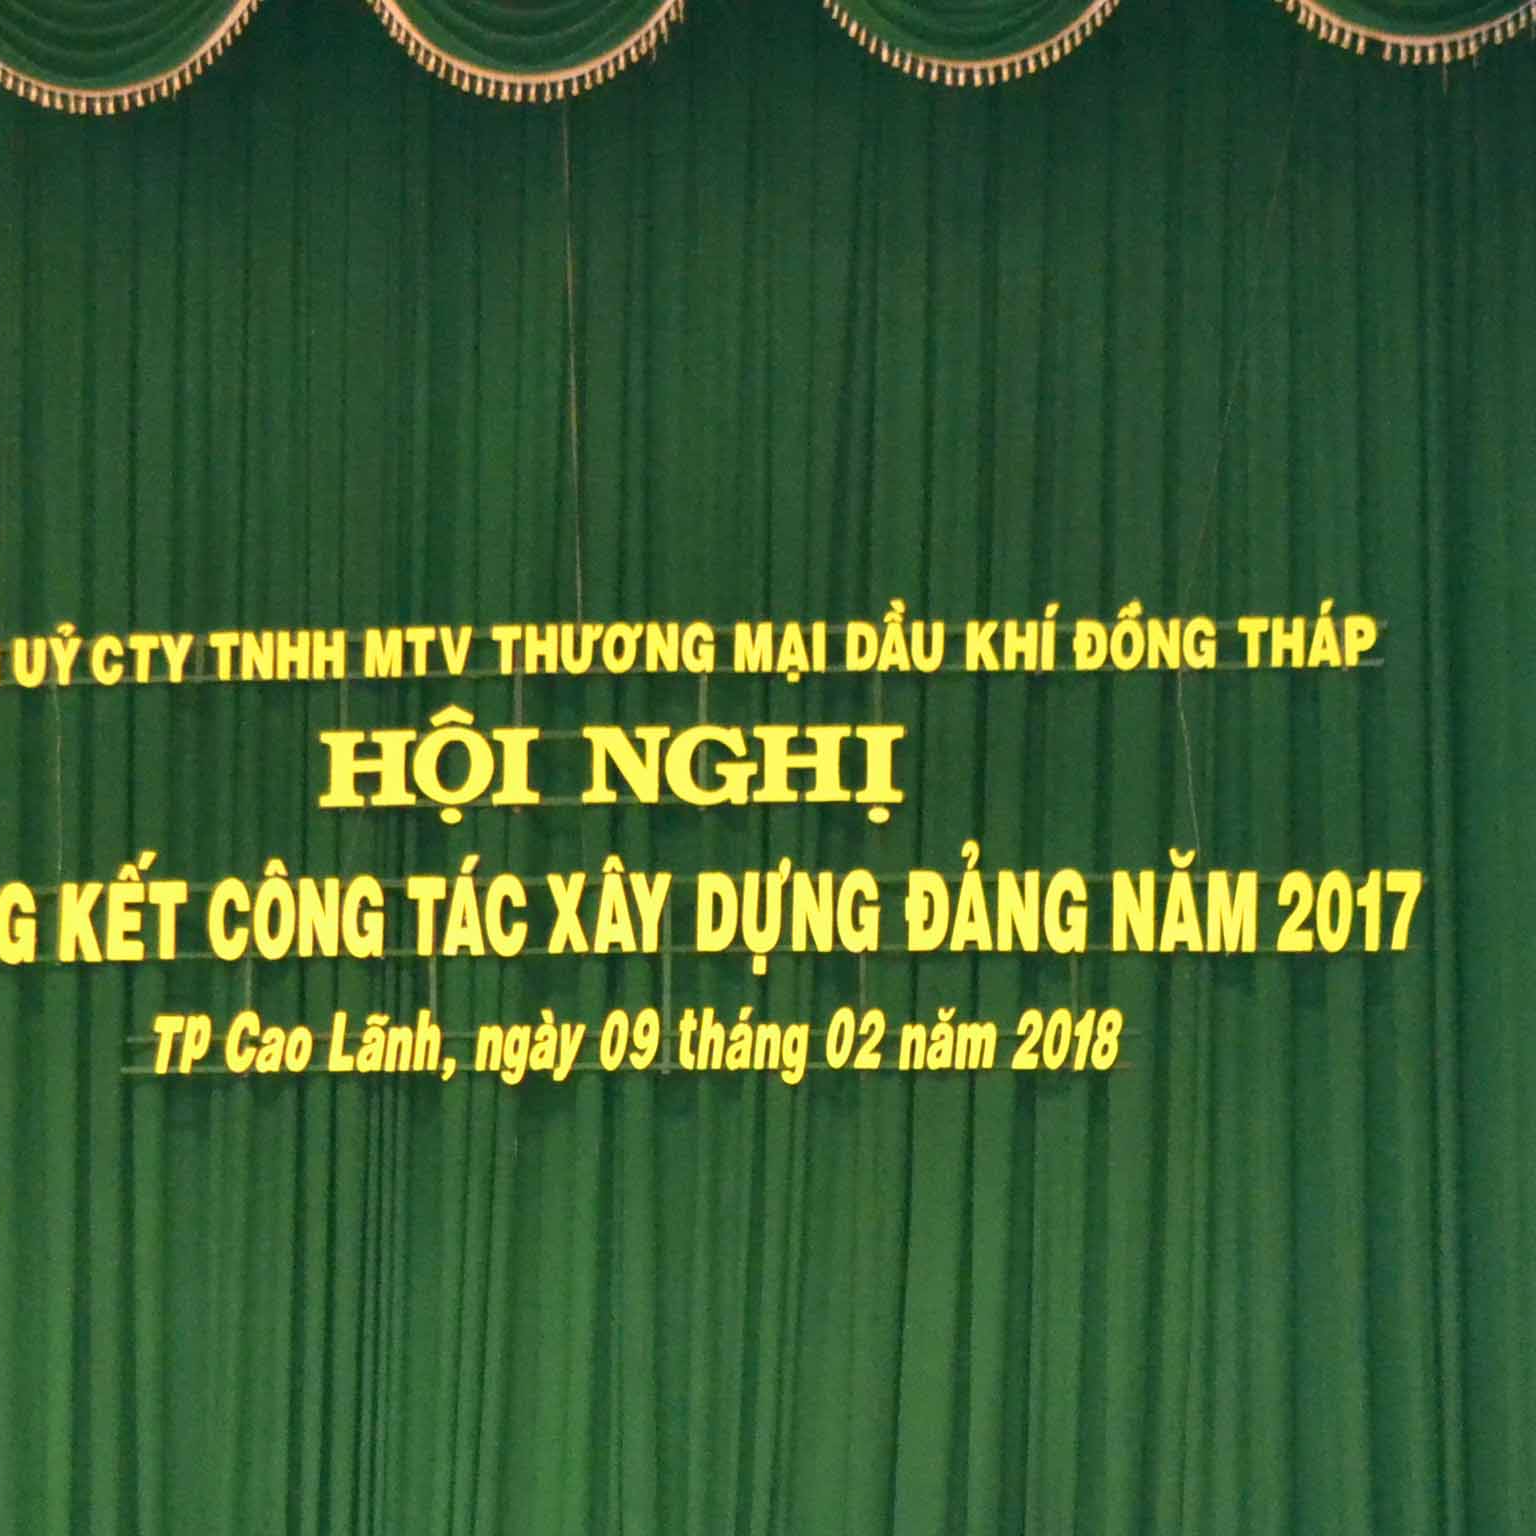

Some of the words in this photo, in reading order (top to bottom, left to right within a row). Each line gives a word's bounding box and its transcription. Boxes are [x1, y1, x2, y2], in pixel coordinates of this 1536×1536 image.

[13, 622, 83, 688] UỶ
[91, 633, 195, 686] CTY
[208, 630, 346, 680] TNHH
[364, 625, 474, 678] MTV
[491, 621, 715, 675] THƯƠNG
[733, 621, 826, 683] MẠI
[845, 599, 945, 673] DẦU
[965, 603, 1060, 671] KHÍ
[1072, 600, 1217, 671] ĐỒNG
[1237, 599, 1378, 668] THÁP
[319, 704, 541, 824] HỘI
[581, 724, 906, 824] NGHỊ
[58, 850, 188, 963] KẾT
[208, 857, 384, 961] CÔNG
[407, 854, 528, 957] TÁC
[546, 855, 672, 954] XÂY
[696, 857, 881, 976] DỰNG
[904, 839, 1088, 954] ĐẢNG
[1112, 847, 1258, 953] NĂM
[1276, 869, 1423, 953] 2017
[152, 1014, 212, 1075] TP
[225, 1010, 313, 1073] Cao
[327, 1009, 458, 1082] Lãnh,
[474, 1009, 587, 1085] ngày
[599, 1007, 660, 1071] 09
[679, 1006, 809, 1085] tháng
[825, 1007, 886, 1070] 02
[898, 1007, 997, 1071] năm
[1011, 1007, 1124, 1071] 2018
